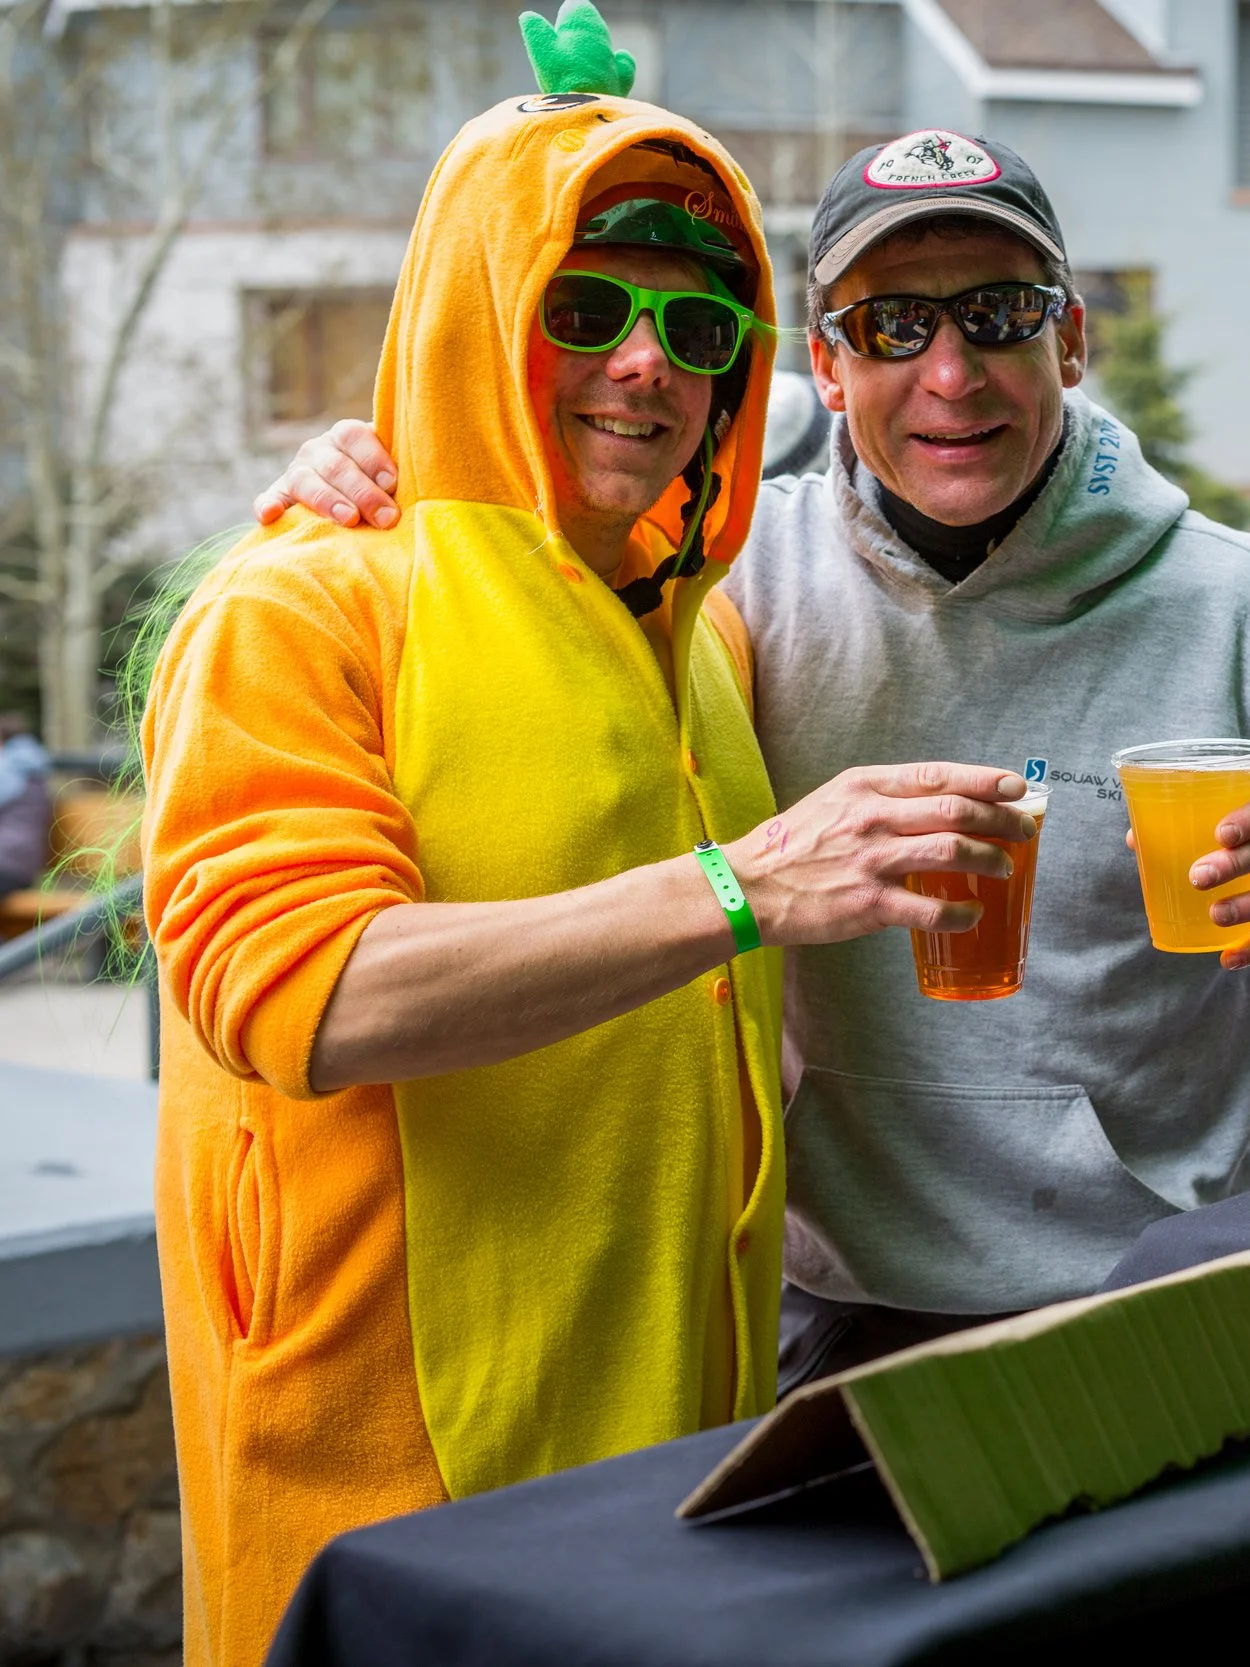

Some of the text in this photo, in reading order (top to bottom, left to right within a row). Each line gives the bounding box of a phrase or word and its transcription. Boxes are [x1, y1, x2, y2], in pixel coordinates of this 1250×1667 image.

[1087, 452, 1118, 496] SVST
[1050, 770, 1108, 787] SQUAW
[1096, 788, 1122, 801] SKI
